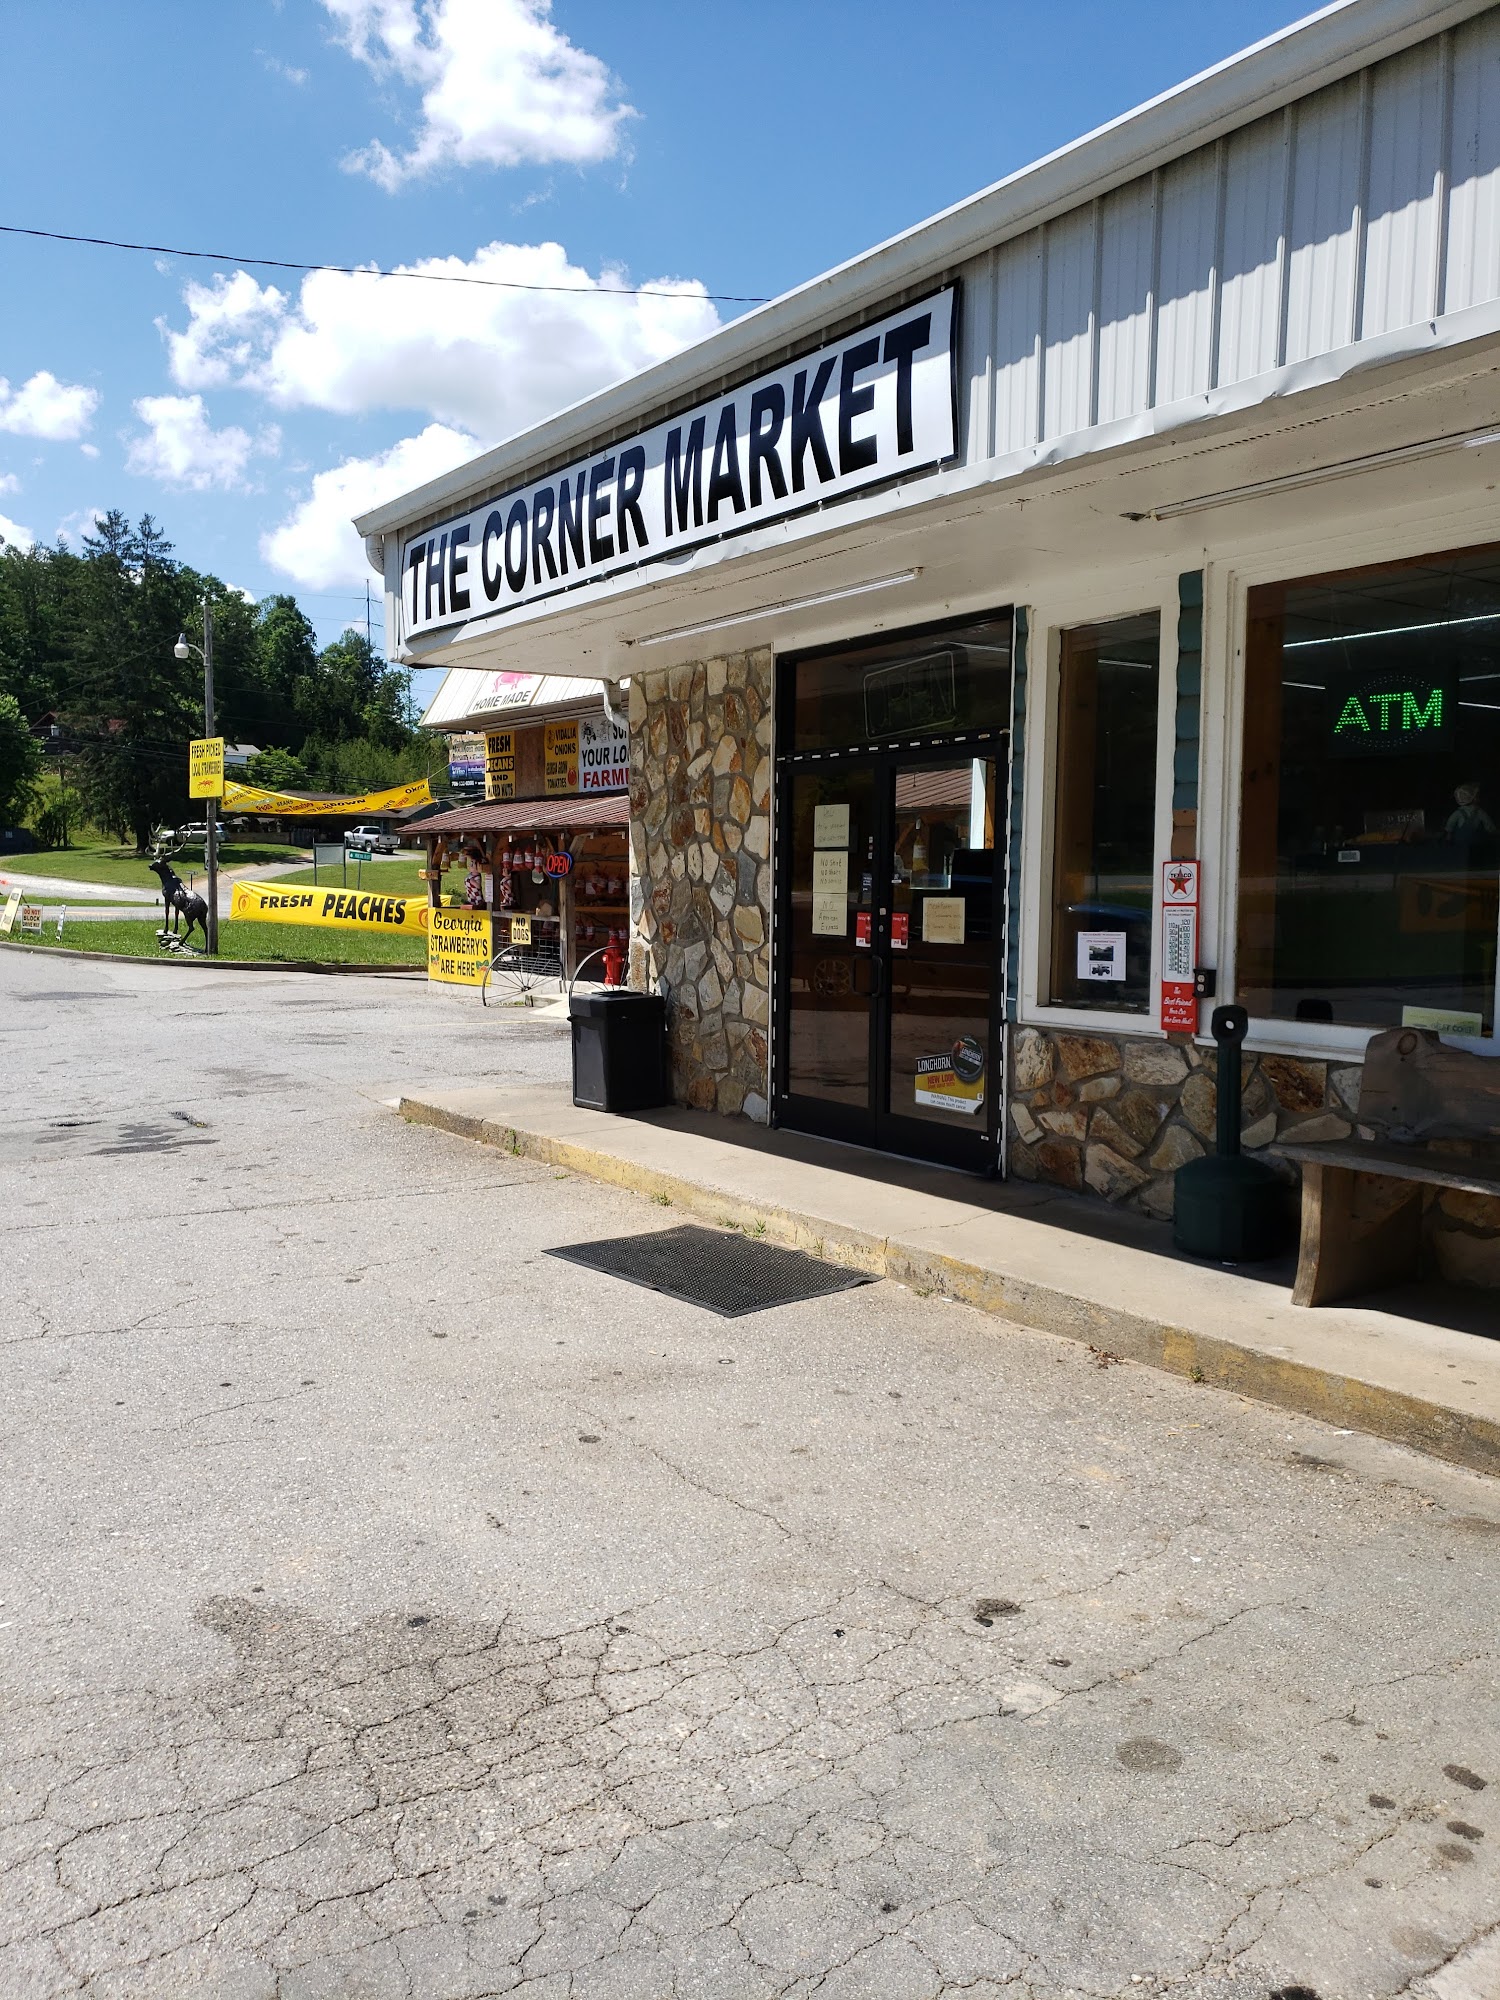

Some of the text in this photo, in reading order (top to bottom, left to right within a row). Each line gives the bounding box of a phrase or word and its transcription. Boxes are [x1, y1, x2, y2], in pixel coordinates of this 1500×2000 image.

[409, 312, 932, 626] THE CORNER MARKET
[473, 690, 531, 711] HOME MADE
[1334, 688, 1443, 733] ATM
[555, 727, 577, 741] VIDALIA
[191, 744, 206, 759] FRESH
[488, 734, 511, 754] FRESH
[554, 742, 577, 756] ONIONS
[486, 757, 514, 772] PECANS
[582, 746, 610, 767] YOUR
[405, 784, 425, 794] Okra
[547, 854, 570, 874] OPEN
[260, 894, 313, 909] FRESH
[322, 893, 407, 925] PEACHES
[31, 908, 41, 916] NOT
[433, 911, 484, 935] Georgia
[515, 917, 526, 926] NO
[513, 927, 530, 942] DOGS
[430, 935, 488, 956] STRAWBERRY'S
[440, 959, 476, 977] ARE HERE
[917, 1056, 952, 1073] LONGHORN
[927, 1073, 955, 1085] NEW LOOK
